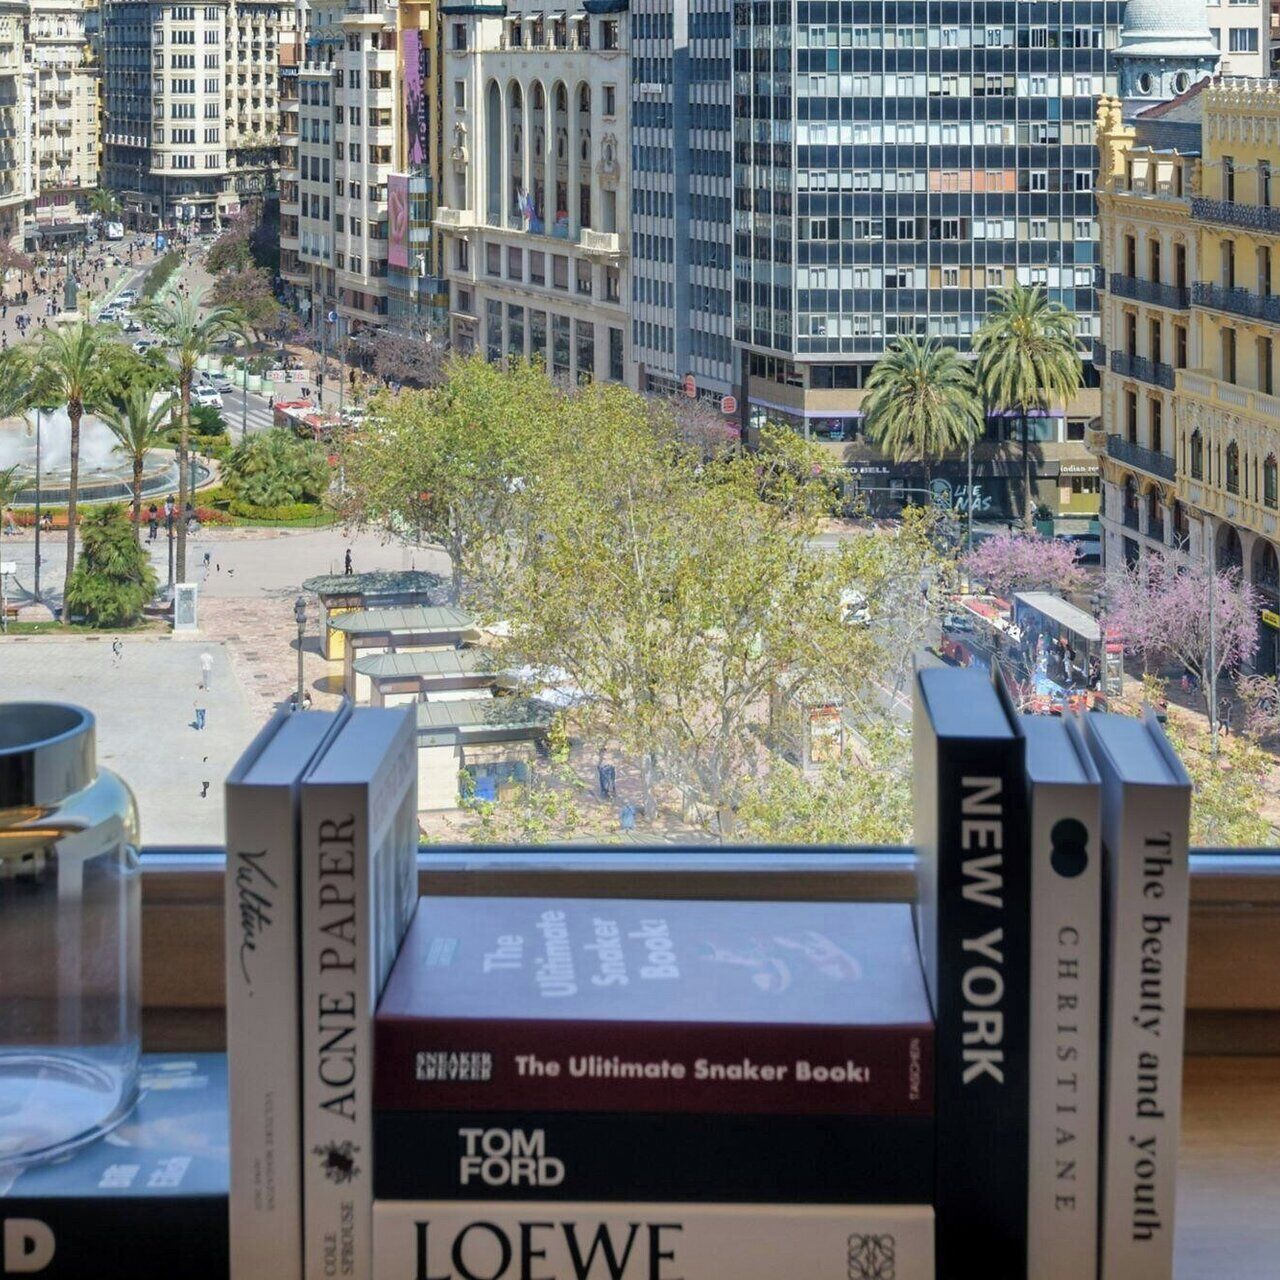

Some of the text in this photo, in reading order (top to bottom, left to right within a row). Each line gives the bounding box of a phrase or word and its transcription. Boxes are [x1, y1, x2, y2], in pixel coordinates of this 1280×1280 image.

[483, 934, 524, 973] The
[583, 917, 629, 987] Snaker
[960, 776, 1005, 1085] NEW YORK
[319, 814, 357, 1122] ACNE PAPER
[515, 1055, 560, 1078] The
[569, 1055, 686, 1080] Ulitimate
[693, 1058, 788, 1082] Snaker
[1054, 925, 1080, 1211] CHRISTIANE
[1128, 831, 1174, 1243] The beauty and youth
[458, 1128, 545, 1158] TOM
[459, 1156, 566, 1187] FORD
[324, 1233, 337, 1279] COLE
[340, 1199, 356, 1278] SPROUSE
[415, 1221, 685, 1280] LOEWE
